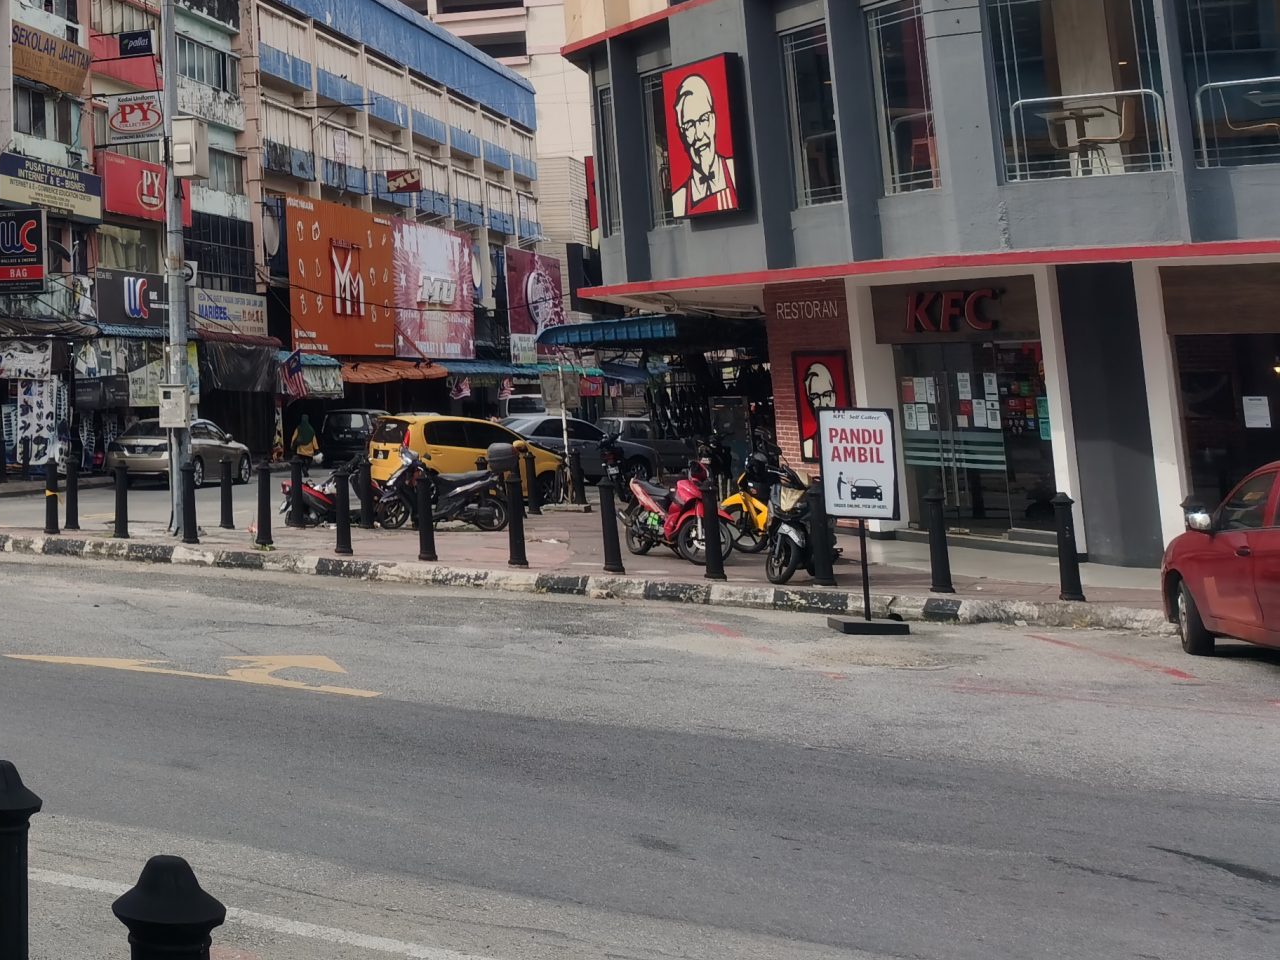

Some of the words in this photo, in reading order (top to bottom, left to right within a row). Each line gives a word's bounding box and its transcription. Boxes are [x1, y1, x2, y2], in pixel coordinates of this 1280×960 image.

[12, 24, 57, 58] SEKOLAH
[59, 43, 93, 71] JAHITAN
[118, 101, 154, 123] PY
[17, 167, 48, 182] INTERNET
[25, 160, 46, 172] PUSAT
[46, 165, 79, 181] PENGAJIAN
[387, 169, 420, 192] MU
[142, 170, 161, 197] PY
[10, 268, 28, 278] BAG
[422, 275, 457, 304] MU
[776, 300, 839, 320] RESTORAN
[906, 289, 994, 332] KFC
[829, 427, 884, 445] PANDU
[831, 446, 885, 464] AMBIL
